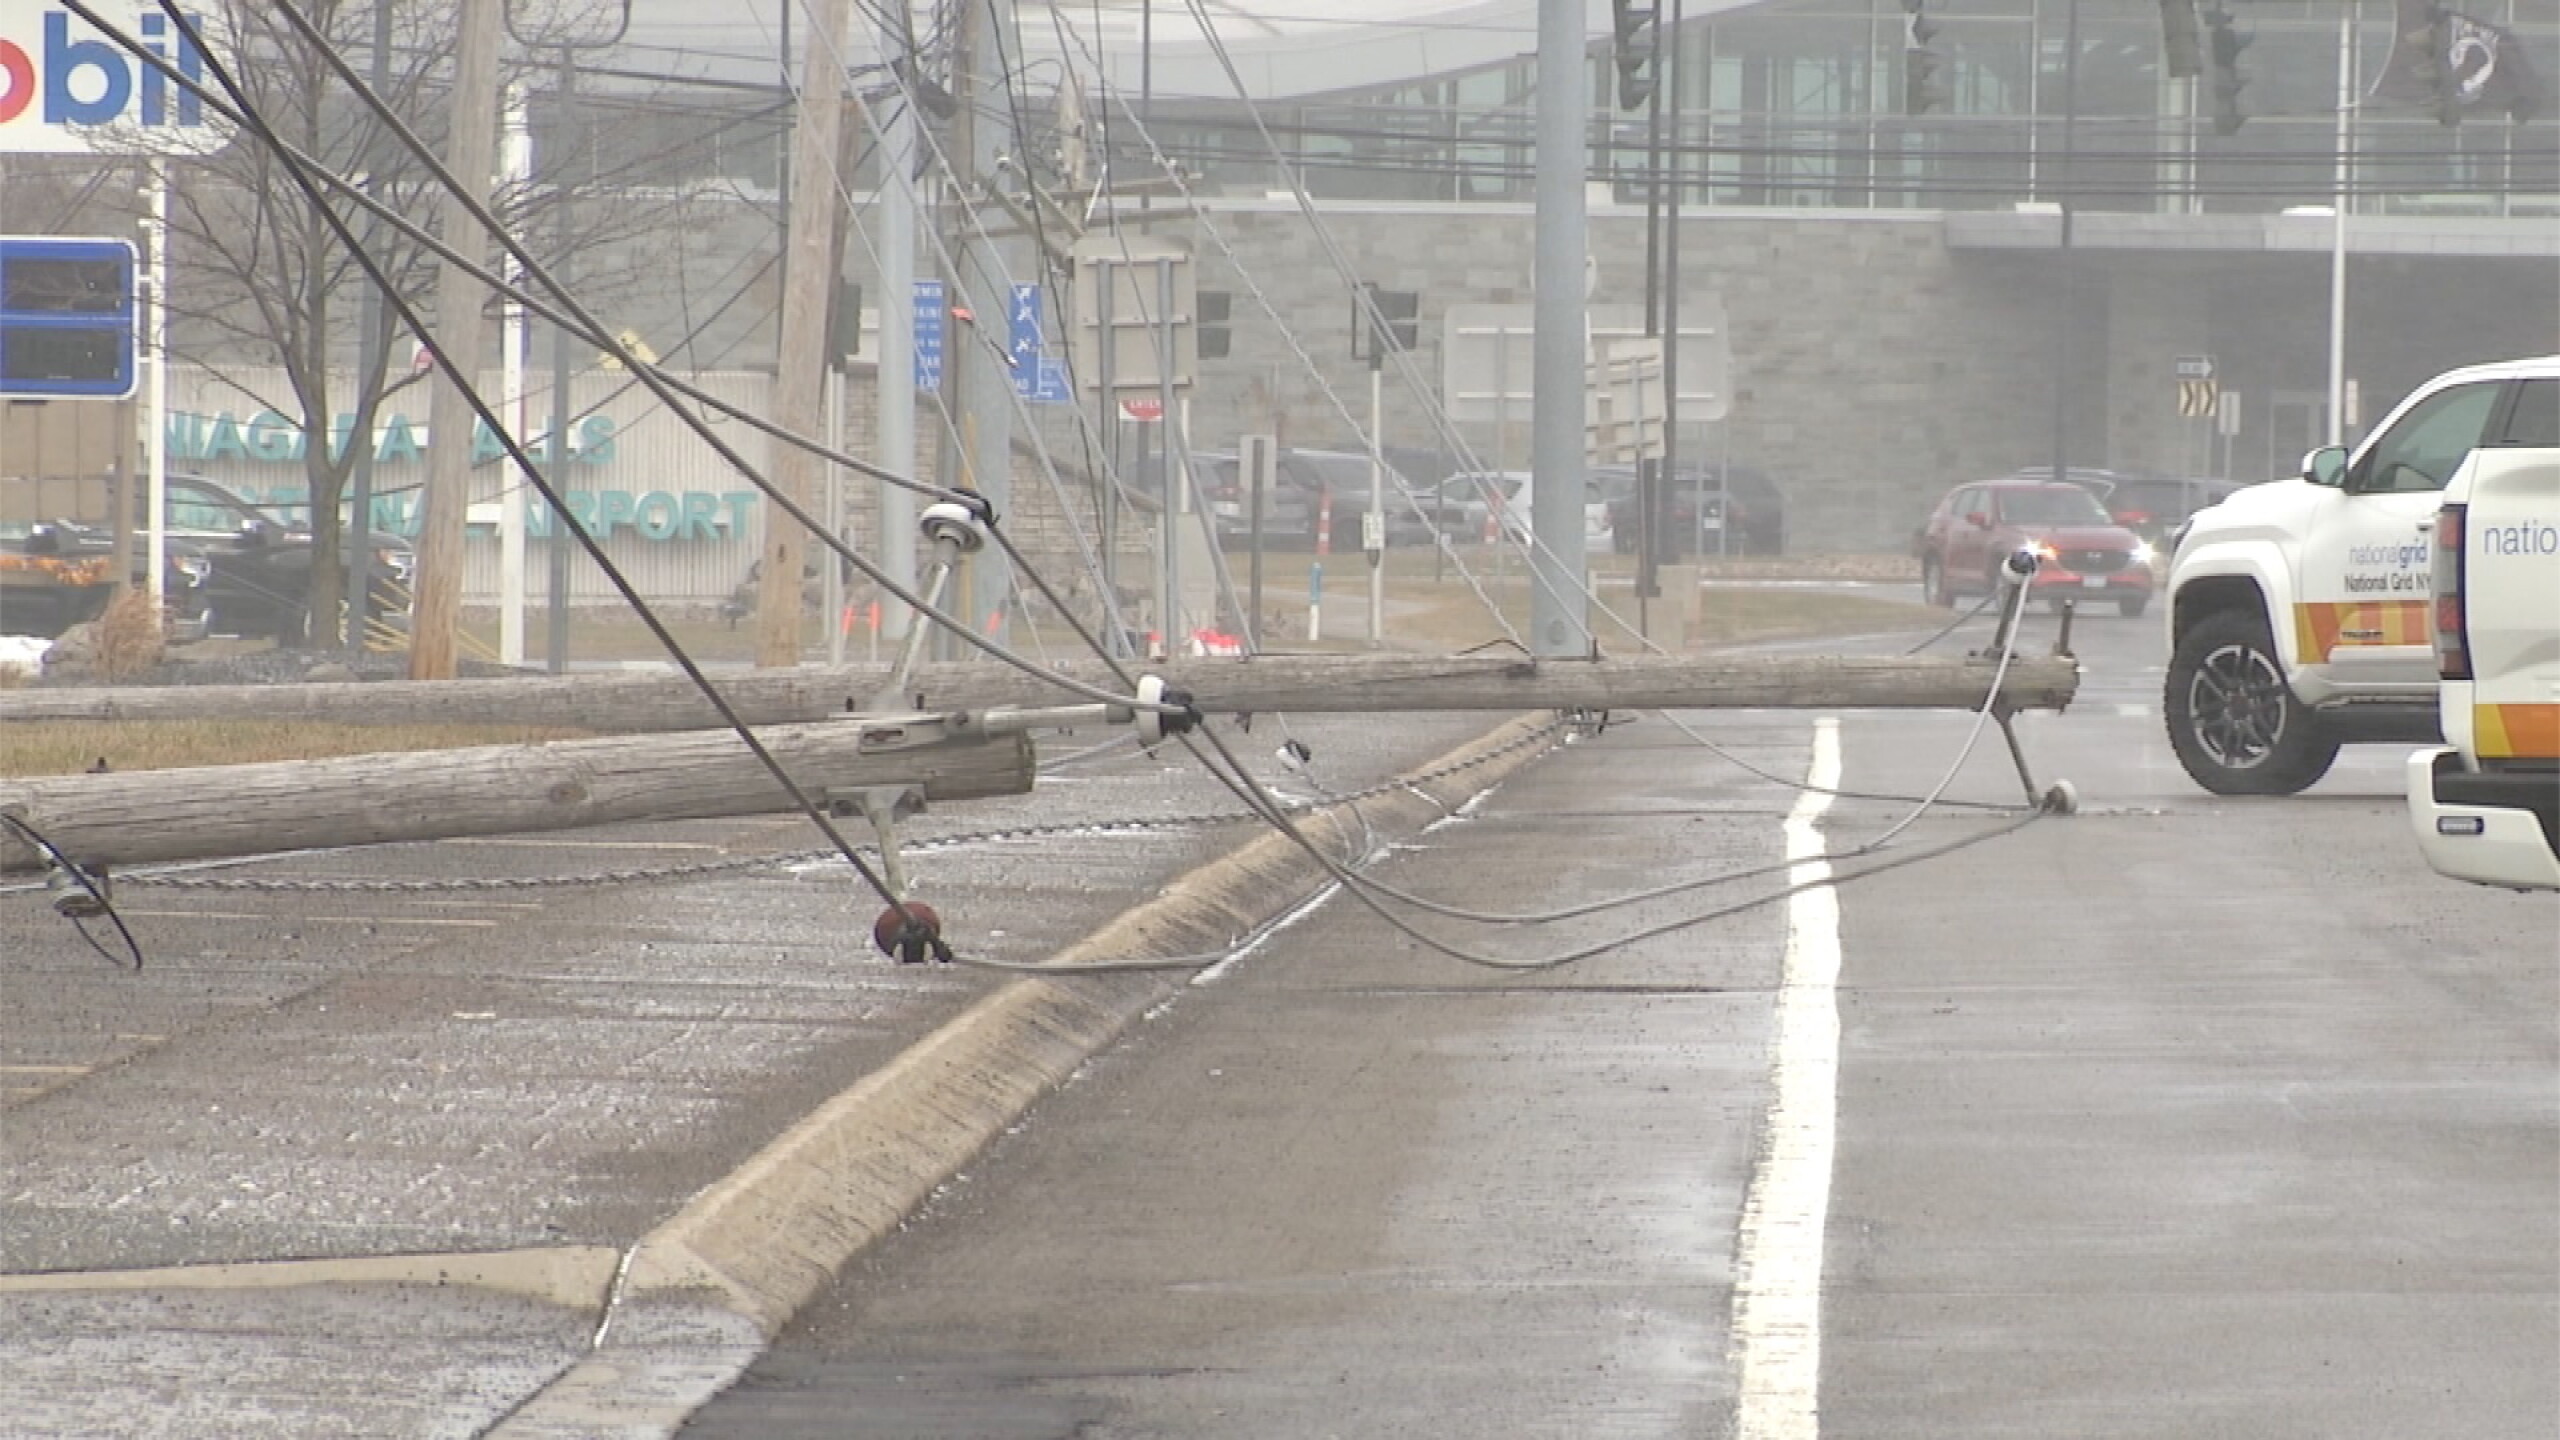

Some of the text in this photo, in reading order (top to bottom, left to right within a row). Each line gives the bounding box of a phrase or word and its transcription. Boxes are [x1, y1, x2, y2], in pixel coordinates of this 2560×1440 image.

[164, 411, 423, 460] NIAGA
[2343, 573, 2387, 592] National
[2392, 572, 2413, 592] Grid
